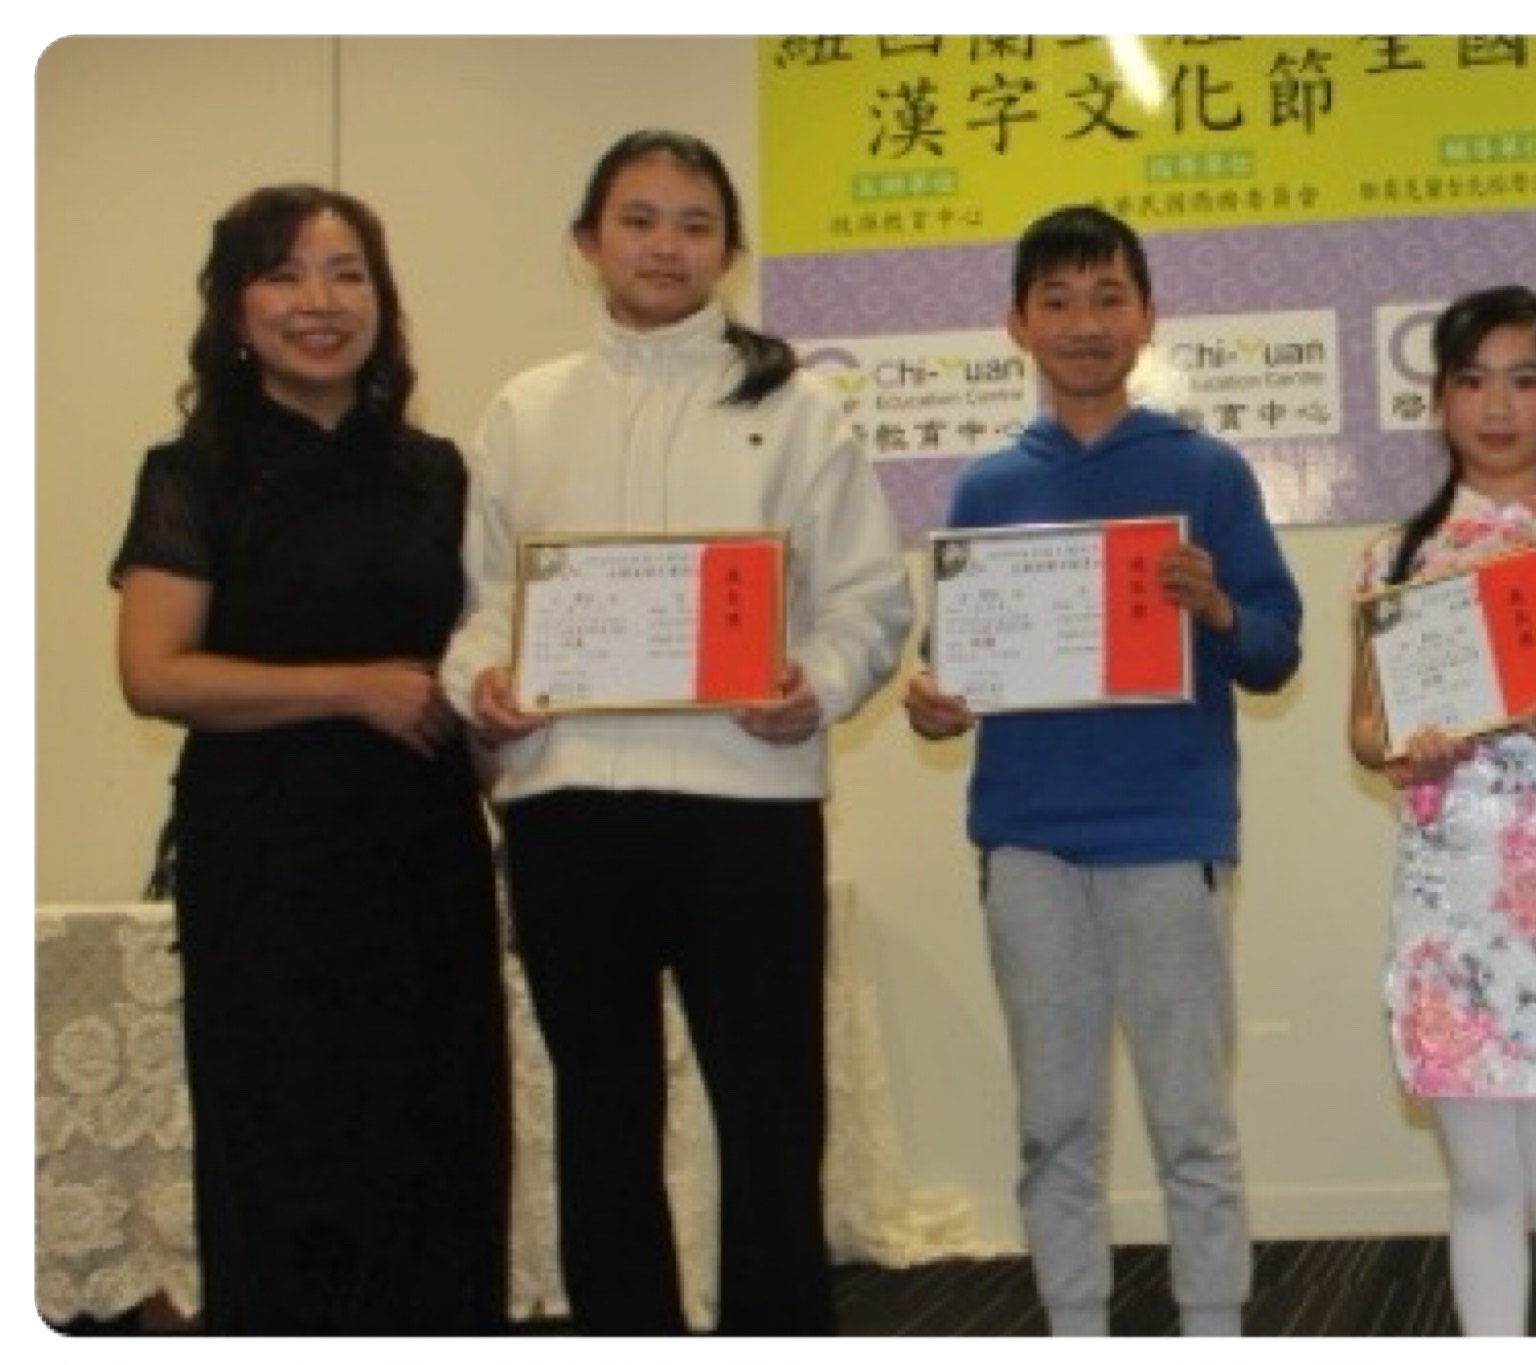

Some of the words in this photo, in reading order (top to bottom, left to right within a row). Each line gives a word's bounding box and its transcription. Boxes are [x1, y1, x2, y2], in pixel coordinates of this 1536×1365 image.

[868, 48, 1333, 158] 漢字文化節
